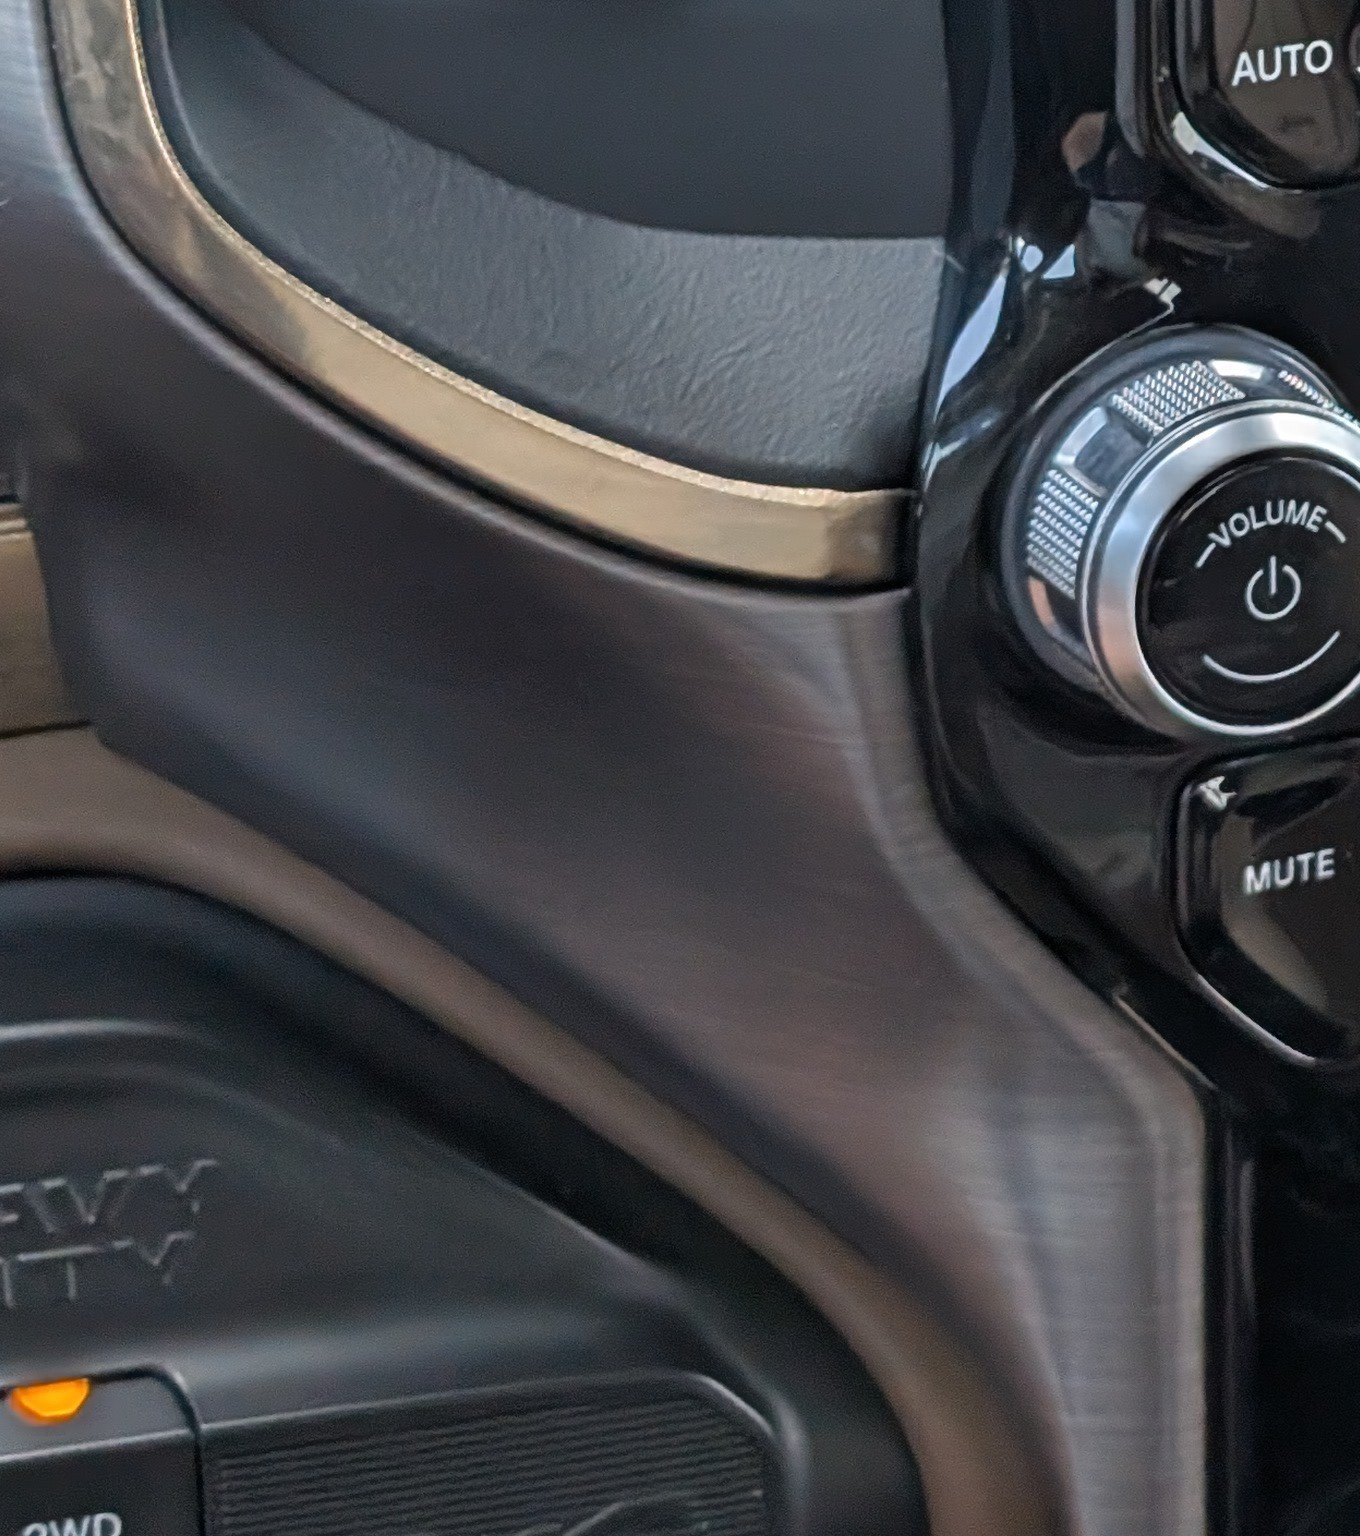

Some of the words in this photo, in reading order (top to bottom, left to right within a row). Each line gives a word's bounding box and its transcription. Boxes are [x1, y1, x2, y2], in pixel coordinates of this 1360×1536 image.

[1232, 41, 1334, 86] AUTO
[1207, 500, 1327, 549] VOLUME
[1244, 849, 1335, 894] MUTE
